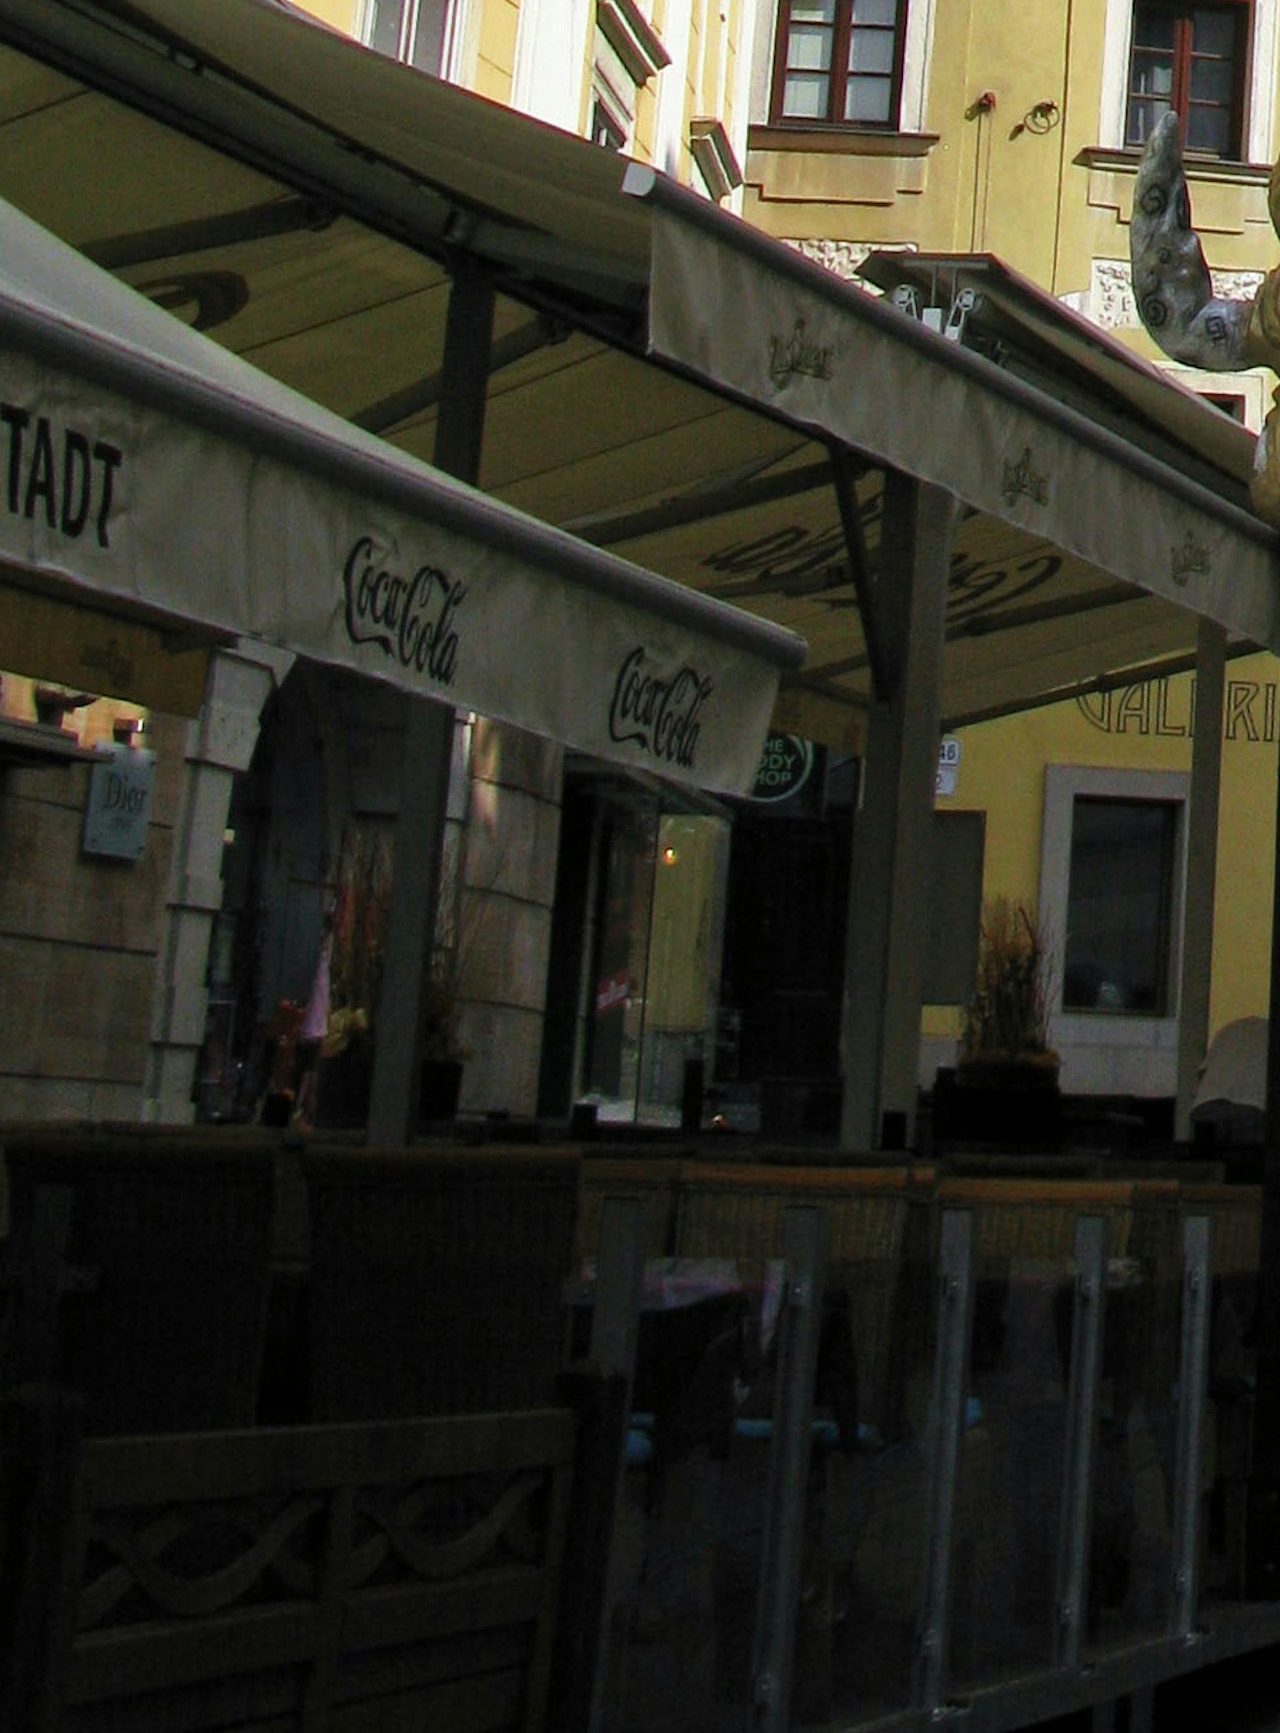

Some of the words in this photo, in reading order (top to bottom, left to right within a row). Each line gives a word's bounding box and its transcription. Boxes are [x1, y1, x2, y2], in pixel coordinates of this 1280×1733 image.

[765, 738, 784, 753] HE
[760, 753, 797, 770] ODY
[755, 770, 792, 787] HOP
